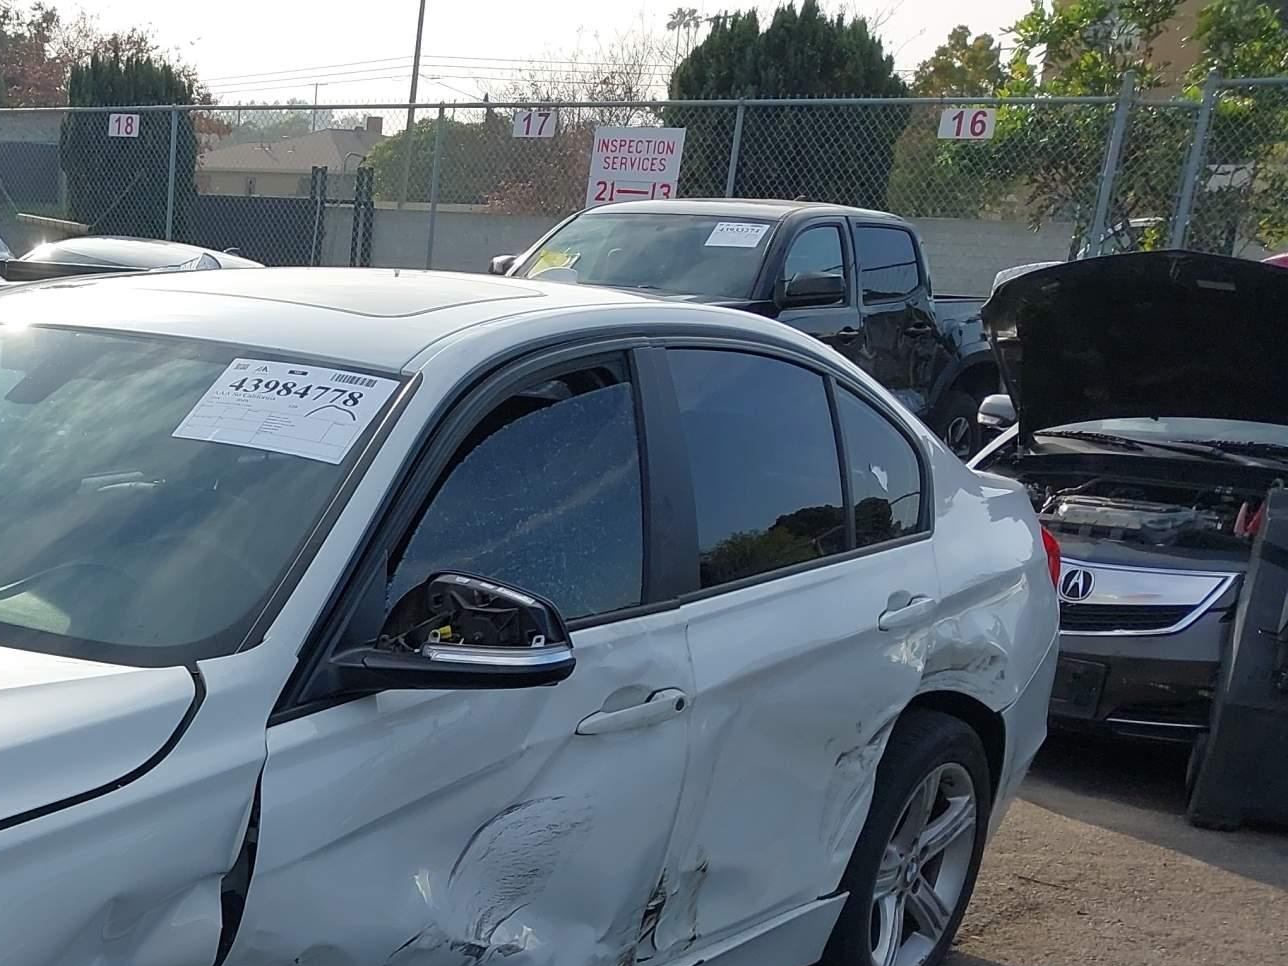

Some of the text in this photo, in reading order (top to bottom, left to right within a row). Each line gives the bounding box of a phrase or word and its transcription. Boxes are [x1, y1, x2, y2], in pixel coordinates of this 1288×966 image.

[115, 116, 134, 135] 18
[523, 113, 551, 136] 17
[952, 110, 988, 137] 16
[597, 138, 676, 155] INSPECTION
[603, 156, 667, 172] SERVICES
[229, 377, 364, 407] 43984778
